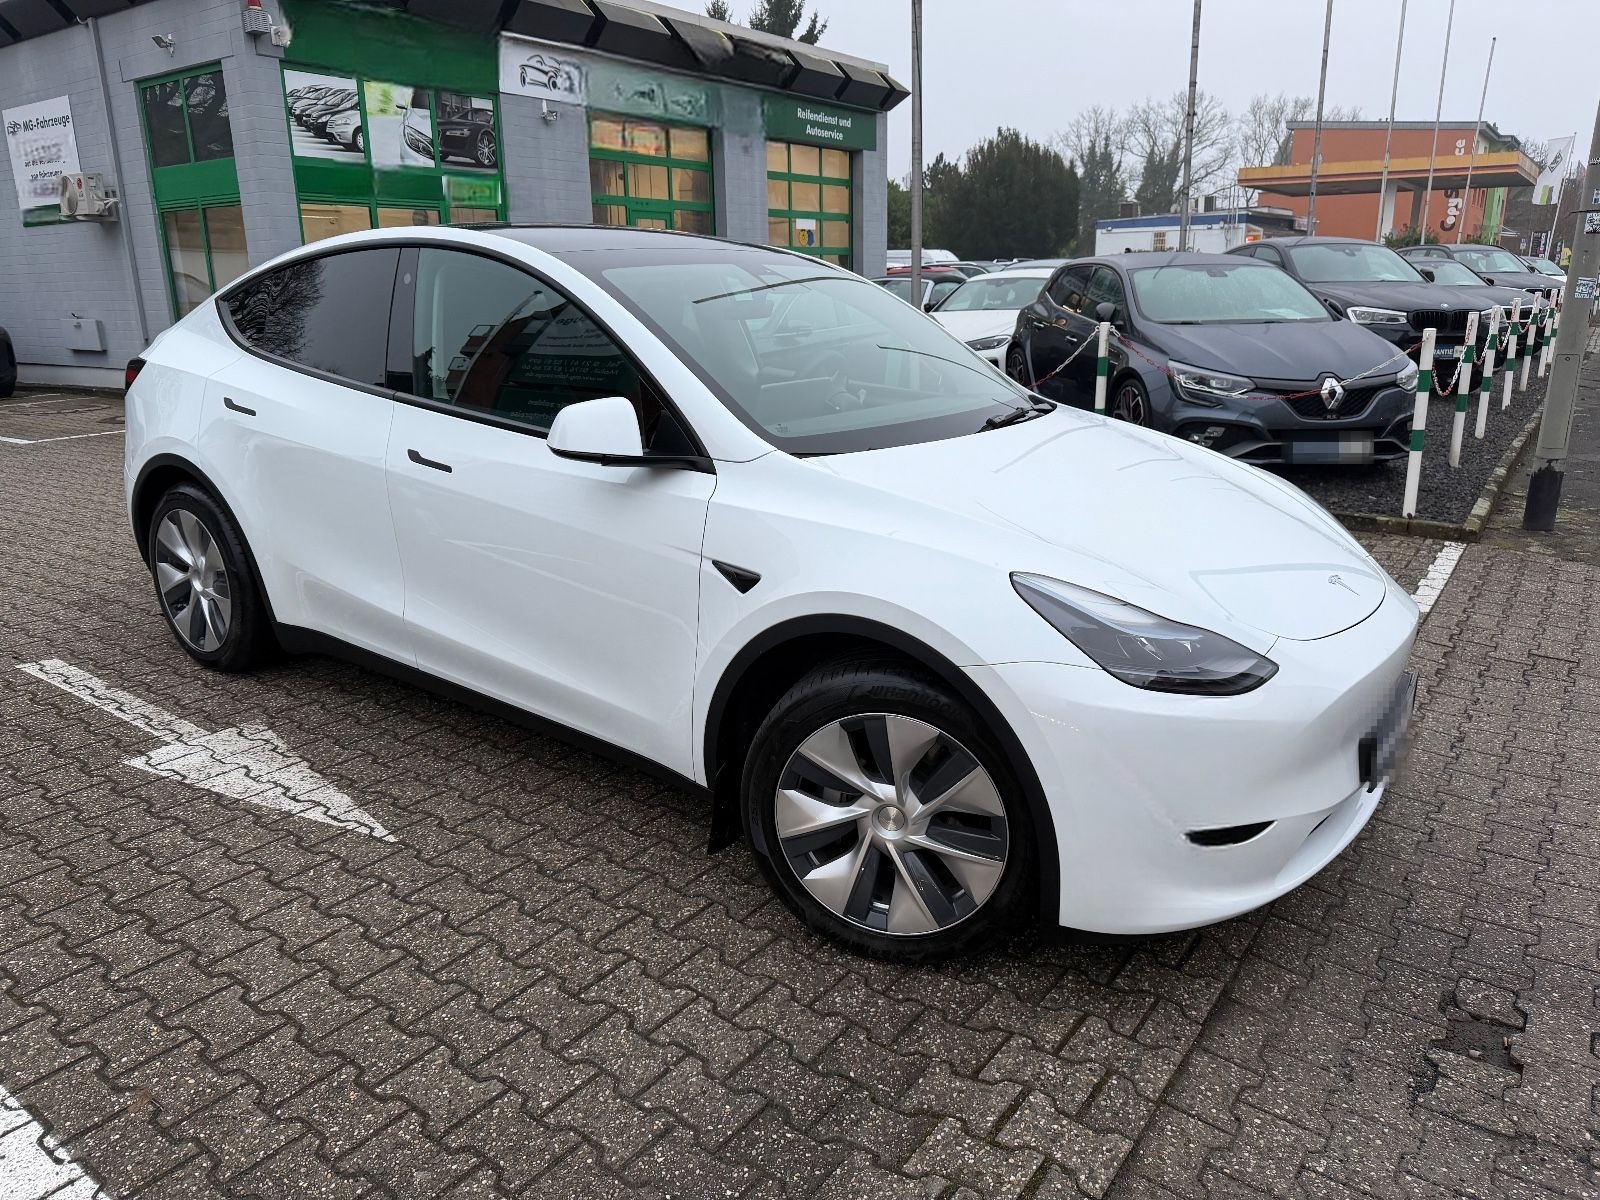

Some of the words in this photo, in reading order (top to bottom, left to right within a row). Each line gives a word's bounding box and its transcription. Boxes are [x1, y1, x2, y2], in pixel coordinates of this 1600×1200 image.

[22, 114, 70, 132] MG-Fahrzeuge
[797, 107, 838, 126] Reifendienst
[838, 118, 852, 128] und
[805, 124, 844, 140] Autoservice
